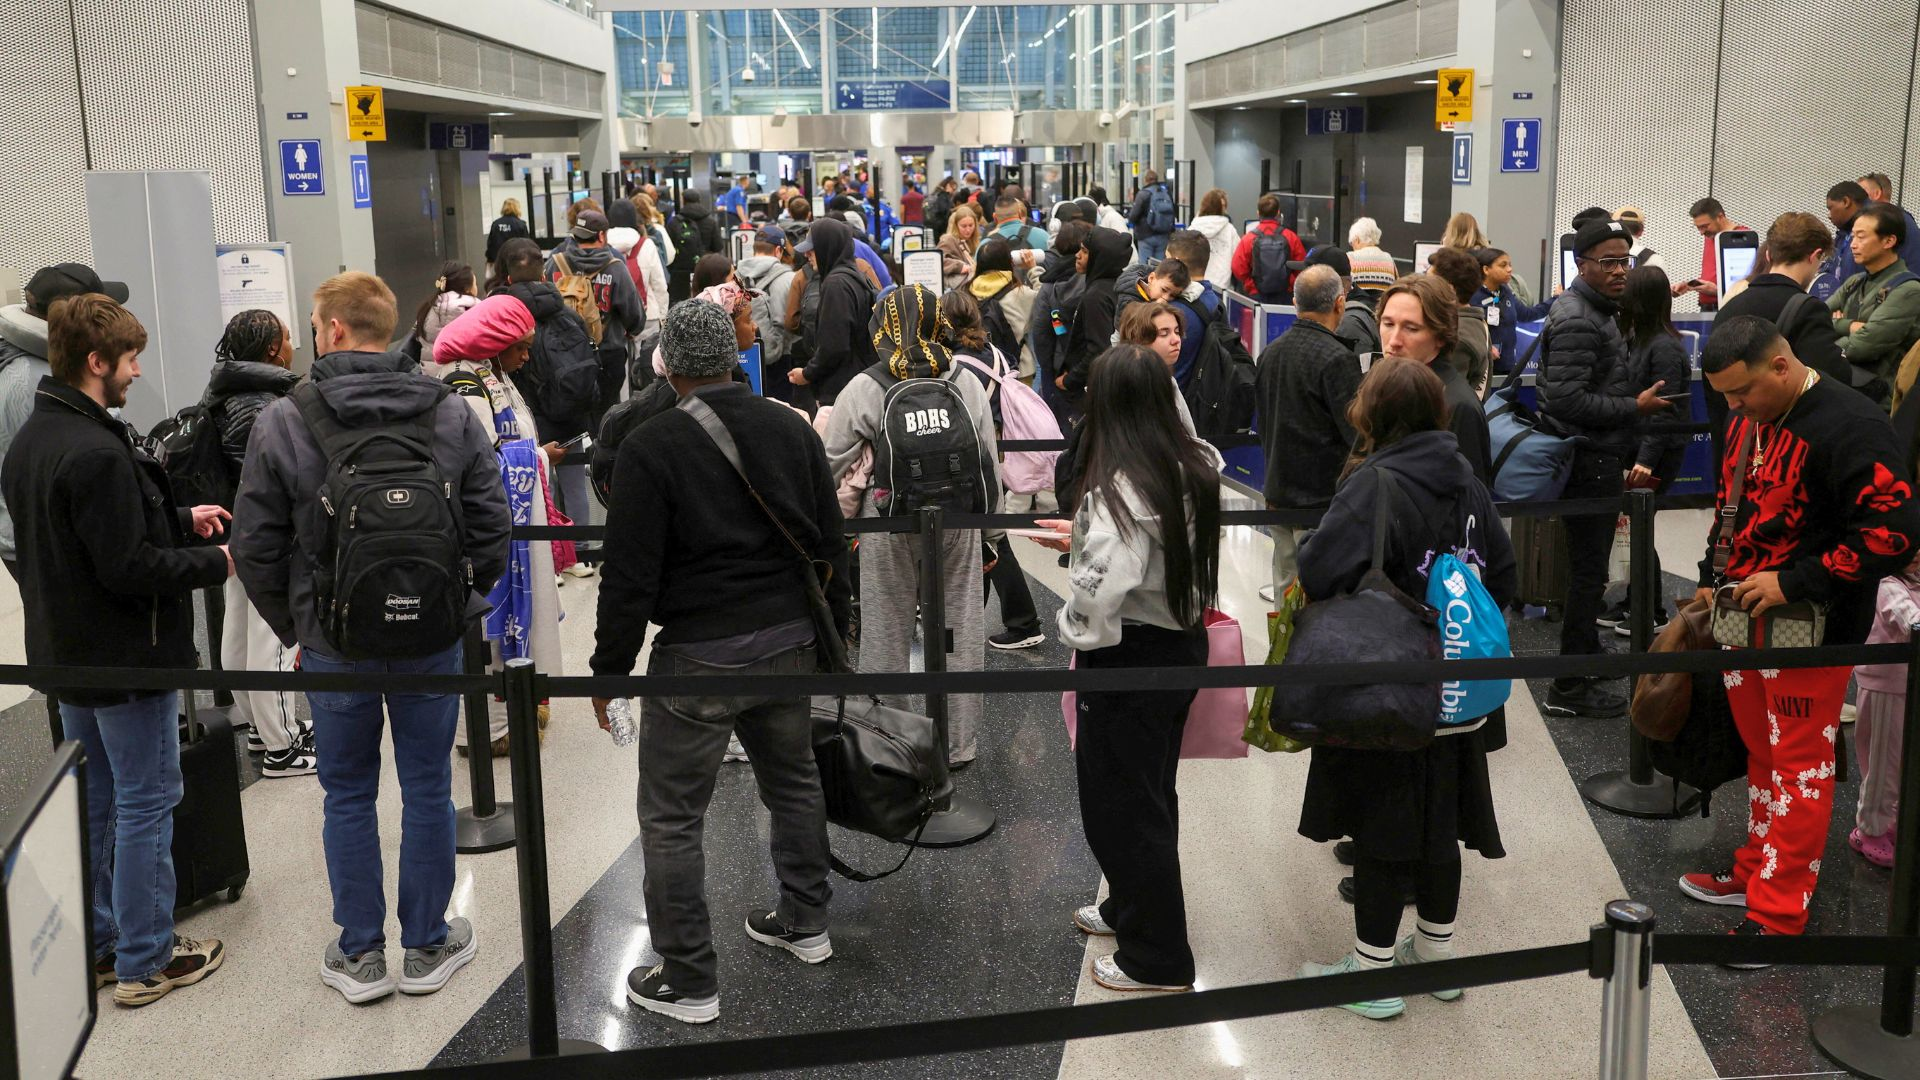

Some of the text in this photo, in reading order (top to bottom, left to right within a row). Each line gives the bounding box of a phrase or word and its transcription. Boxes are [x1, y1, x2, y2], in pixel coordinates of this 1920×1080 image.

[498, 224, 511, 232] TSA
[904, 408, 950, 433] BDHS
[916, 425, 943, 437] cheer
[1773, 694, 1813, 718] SAINT
[444, 941, 463, 956] HOKA
